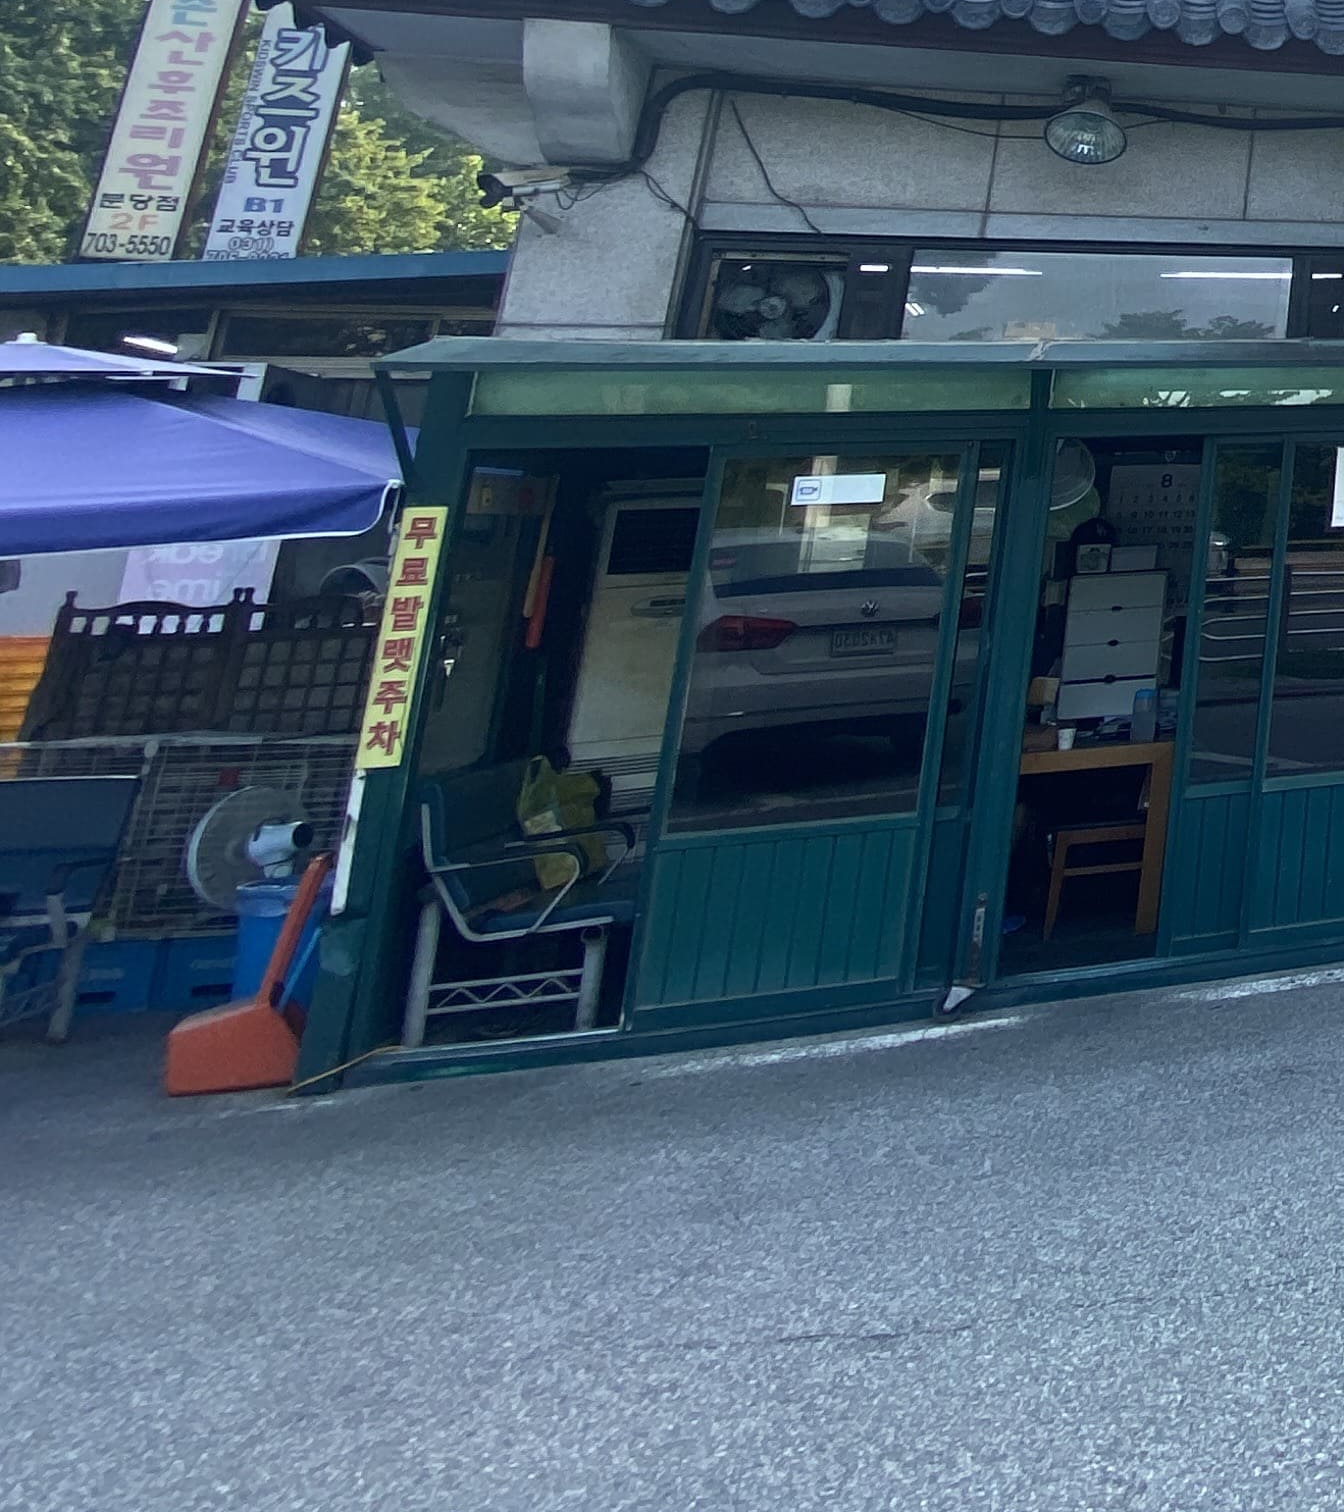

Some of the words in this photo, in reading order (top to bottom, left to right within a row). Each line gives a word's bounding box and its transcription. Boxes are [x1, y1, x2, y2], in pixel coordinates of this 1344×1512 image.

[242, 26, 330, 190] 키즈원
[99, 192, 181, 213] 분당점
[243, 197, 286, 214] B1
[108, 212, 160, 231] 2F
[215, 219, 296, 238] 교육상담
[85, 232, 171, 256] 703-5550
[1161, 473, 1173, 488] 8
